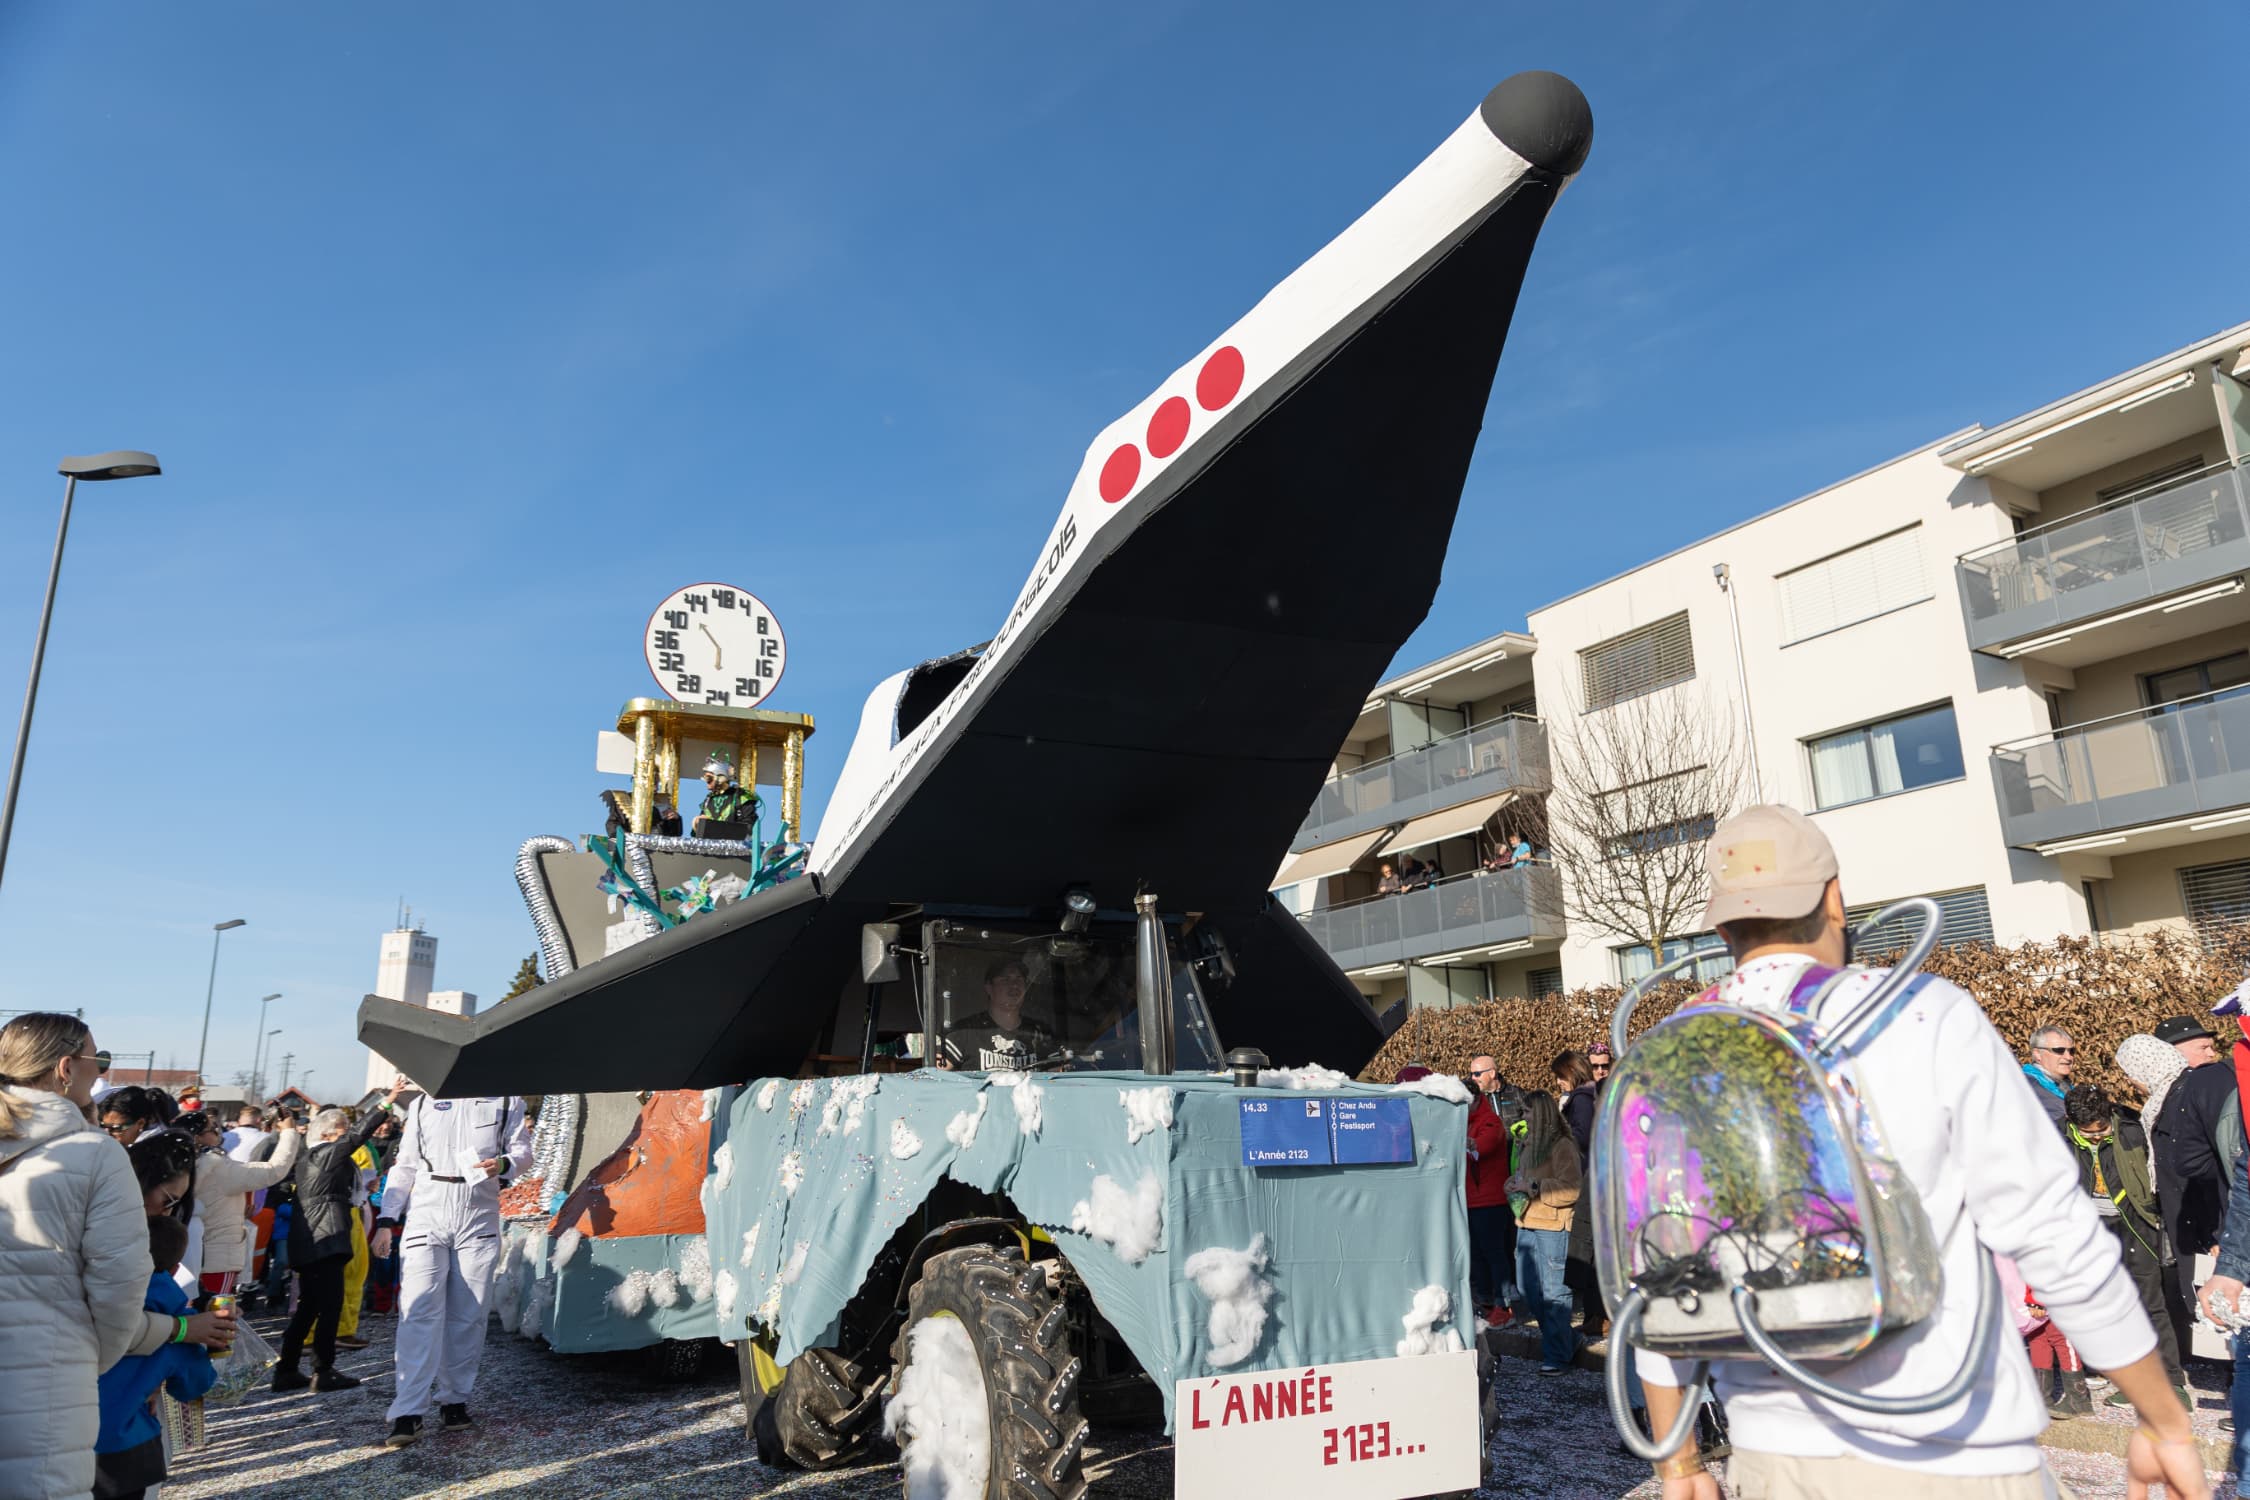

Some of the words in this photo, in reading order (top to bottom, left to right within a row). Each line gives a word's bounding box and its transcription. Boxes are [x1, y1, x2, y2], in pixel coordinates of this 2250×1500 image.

[684, 593, 708, 614] 44
[711, 588, 735, 609] 48
[739, 598, 751, 617] 4
[664, 610, 689, 630] 40
[757, 616, 768, 635] 8
[654, 630, 680, 650] 36
[760, 638, 778, 657] 12
[658, 651, 685, 673] 32
[755, 658, 773, 678] 16
[677, 674, 702, 694] 28
[735, 677, 760, 698] 20
[706, 689, 729, 707] 24
[1243, 1103, 1268, 1113] 14.33
[1339, 1112, 1357, 1120] Gare
[1339, 1122, 1376, 1131] Festisport
[1249, 1149, 1287, 1161] L'Année
[1288, 1150, 1309, 1160] 2123
[1323, 1420, 1426, 1466] 2123...
